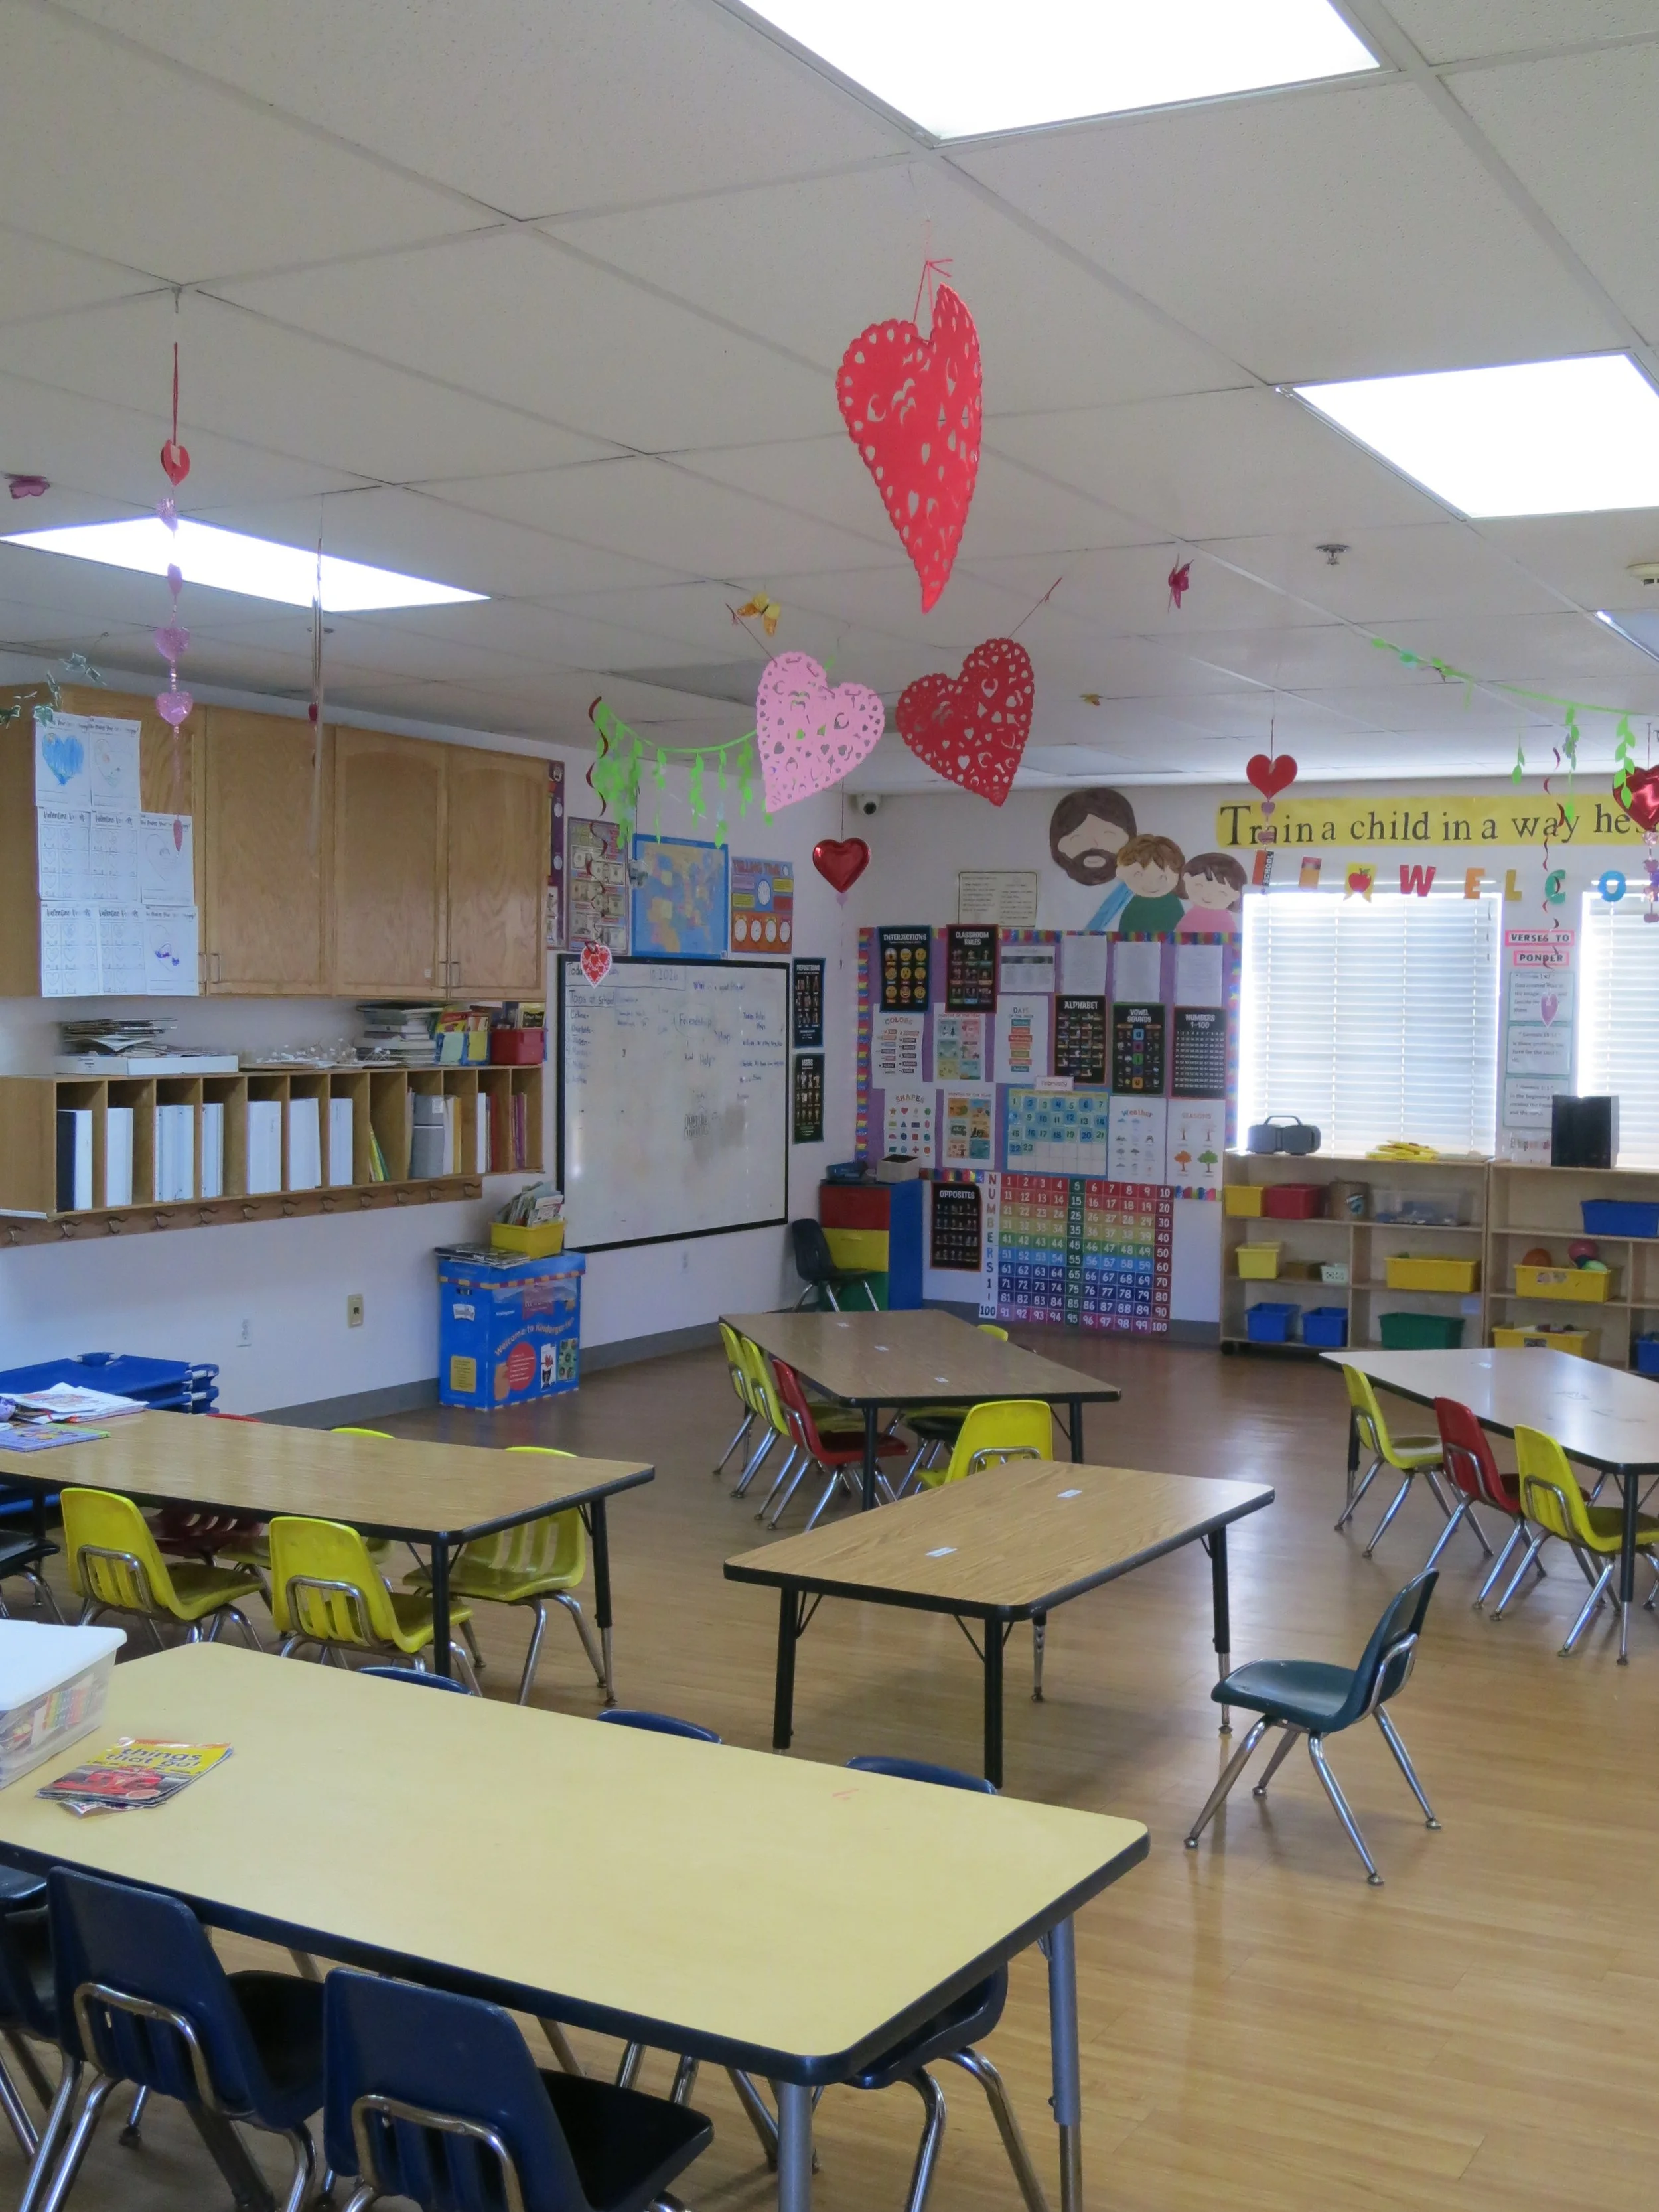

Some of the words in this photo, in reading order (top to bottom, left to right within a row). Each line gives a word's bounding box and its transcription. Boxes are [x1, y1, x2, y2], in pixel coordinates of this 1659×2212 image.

[1220, 806, 1313, 846] Train
[1322, 822, 1336, 840] a
[1350, 811, 1431, 840] child
[1443, 812, 1471, 840] in
[1482, 819, 1498, 840] a
[1512, 814, 1580, 844] way
[1263, 854, 1273, 883] SCHOOL
[1519, 954, 1563, 962] PONDER
[1064, 1001, 1098, 1009] ALPHABET
[895, 1094, 924, 1104] SHAPES
[1121, 1109, 1153, 1118] Weather
[940, 1190, 975, 1199] OPPOSITES
[1007, 1176, 1011, 1185] 1
[1023, 1177, 1029, 1187] 2
[1041, 1179, 1045, 1188] 3
[1057, 1180, 1062, 1189] 4
[1074, 1181, 1080, 1191] 5
[1092, 1183, 1097, 1192] 6
[1109, 1184, 1115, 1193] 7
[1126, 1185, 1133, 1195] 8
[1144, 1187, 1151, 1196] 9
[1160, 1188, 1170, 1198] 10
[1005, 1191, 1012, 1200] 11
[1021, 1192, 1030, 1201] 12
[1038, 1193, 1046, 1203] 13
[1054, 1195, 1064, 1205] 14
[1072, 1196, 1082, 1205] 15
[1089, 1197, 1099, 1207] 16
[1106, 1199, 1116, 1208] 17
[1124, 1201, 1134, 1210] 18
[1142, 1202, 1151, 1211] 19
[1159, 1203, 1170, 1213] 20
[1070, 1211, 1081, 1220] 25
[1159, 1218, 1169, 1228] 30
[1070, 1225, 1081, 1235] 35
[1158, 1233, 1169, 1242] 40
[1069, 1240, 1080, 1250] 45
[1157, 1248, 1169, 1258] 50
[1069, 1255, 1081, 1264] 55
[1157, 1262, 1169, 1272] 60
[1001, 1264, 1011, 1274] 61
[1018, 1266, 1029, 1275] 62
[1035, 1267, 1045, 1276] 63
[1051, 1268, 1062, 1278] 64
[1068, 1270, 1080, 1279] 65
[1085, 1271, 1096, 1280] 66
[1102, 1272, 1114, 1282] 67
[1120, 1274, 1133, 1284] 68
[1138, 1276, 1150, 1285] 69
[1157, 1277, 1167, 1287] 70
[1002, 1278, 1011, 1288] 71
[1018, 1280, 1028, 1290] 72
[1035, 1282, 1045, 1291] 73
[1052, 1283, 1062, 1292] 74
[1069, 1284, 1079, 1293] 75
[1085, 1286, 1095, 1295] 76
[1102, 1287, 1113, 1297] 77
[1119, 1289, 1131, 1299] 78
[1138, 1290, 1149, 1300] 79
[1155, 1292, 1168, 1302] 80
[980, 1305, 996, 1315] 100
[1001, 1293, 1011, 1303] 81
[1017, 1295, 1028, 1304] 82
[1034, 1296, 1045, 1305] 83
[1050, 1297, 1062, 1307] 84
[1068, 1299, 1079, 1308] 85
[1083, 1301, 1095, 1310] 86
[1100, 1302, 1113, 1311] 87
[1118, 1303, 1131, 1313] 88
[1136, 1305, 1149, 1315] 89
[1155, 1307, 1167, 1317] 90
[1000, 1307, 1009, 1317] 91
[1016, 1309, 1027, 1319] 92
[1033, 1310, 1044, 1320] 93
[1050, 1311, 1061, 1321] 94
[1067, 1313, 1078, 1323] 95
[1083, 1315, 1094, 1325] 96
[1100, 1317, 1112, 1327] 97
[1118, 1319, 1129, 1329] 98
[1135, 1320, 1147, 1330] 99
[1152, 1322, 1167, 1332] 100
[494, 1328, 526, 1356] Welcome
[106, 1754, 153, 1764] that
[157, 1759, 201, 1768] go!
[121, 1748, 202, 1761] things
